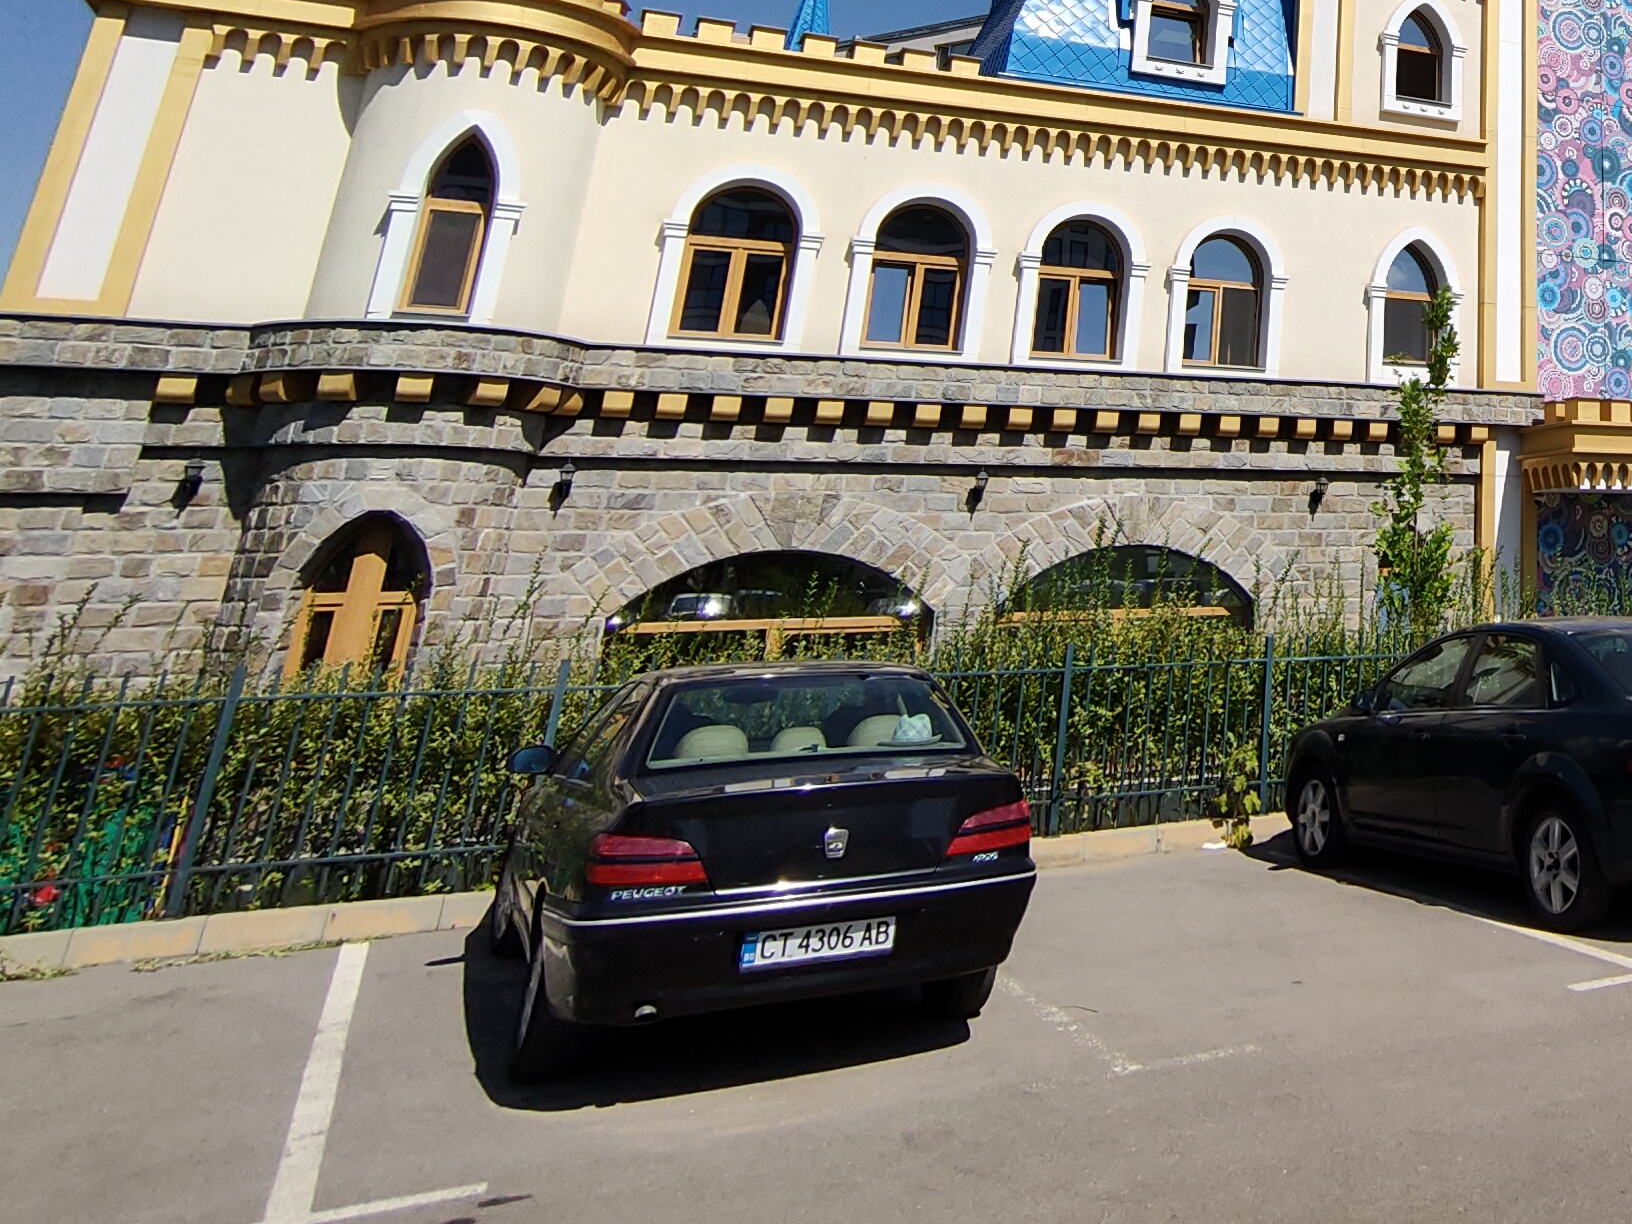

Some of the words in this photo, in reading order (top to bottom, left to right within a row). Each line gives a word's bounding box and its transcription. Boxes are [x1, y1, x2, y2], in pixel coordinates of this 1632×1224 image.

[610, 885, 687, 901] PEUGEOT
[760, 932, 794, 959] CT
[797, 924, 854, 954] 4306
[859, 920, 890, 947] AB
